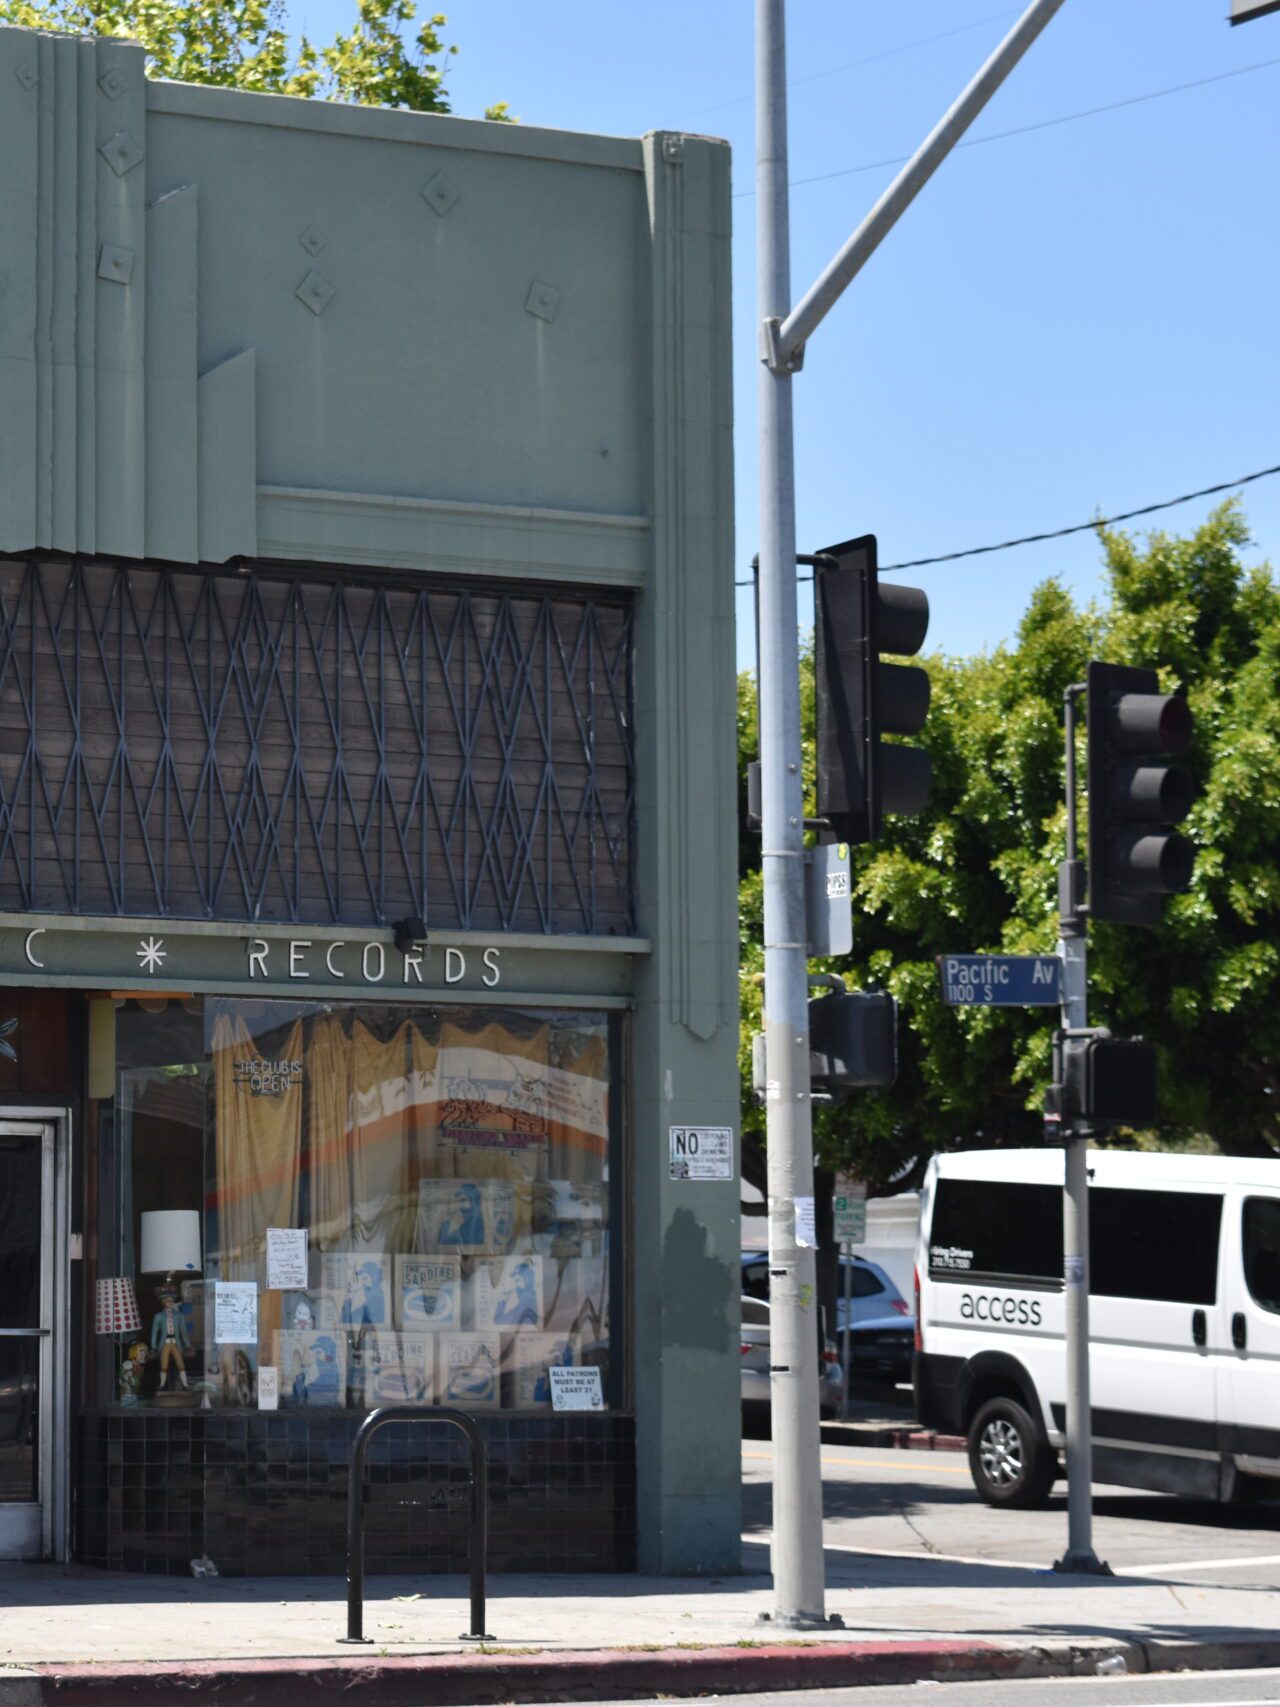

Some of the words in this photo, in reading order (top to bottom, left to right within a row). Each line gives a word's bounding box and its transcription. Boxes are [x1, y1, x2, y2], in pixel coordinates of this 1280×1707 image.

[248, 938, 501, 988] RECORDS
[947, 960, 1009, 984] Pacific
[1032, 960, 1054, 984] Av
[947, 984, 975, 1001] 1100
[983, 984, 993, 1001] S
[240, 1060, 259, 1074] THE
[261, 1060, 290, 1075] CLUB
[290, 1060, 301, 1074] IS
[250, 1074, 290, 1092] OPEN
[676, 1133, 699, 1155] NO
[405, 1265, 420, 1273] THE
[960, 1293, 1042, 1326] access
